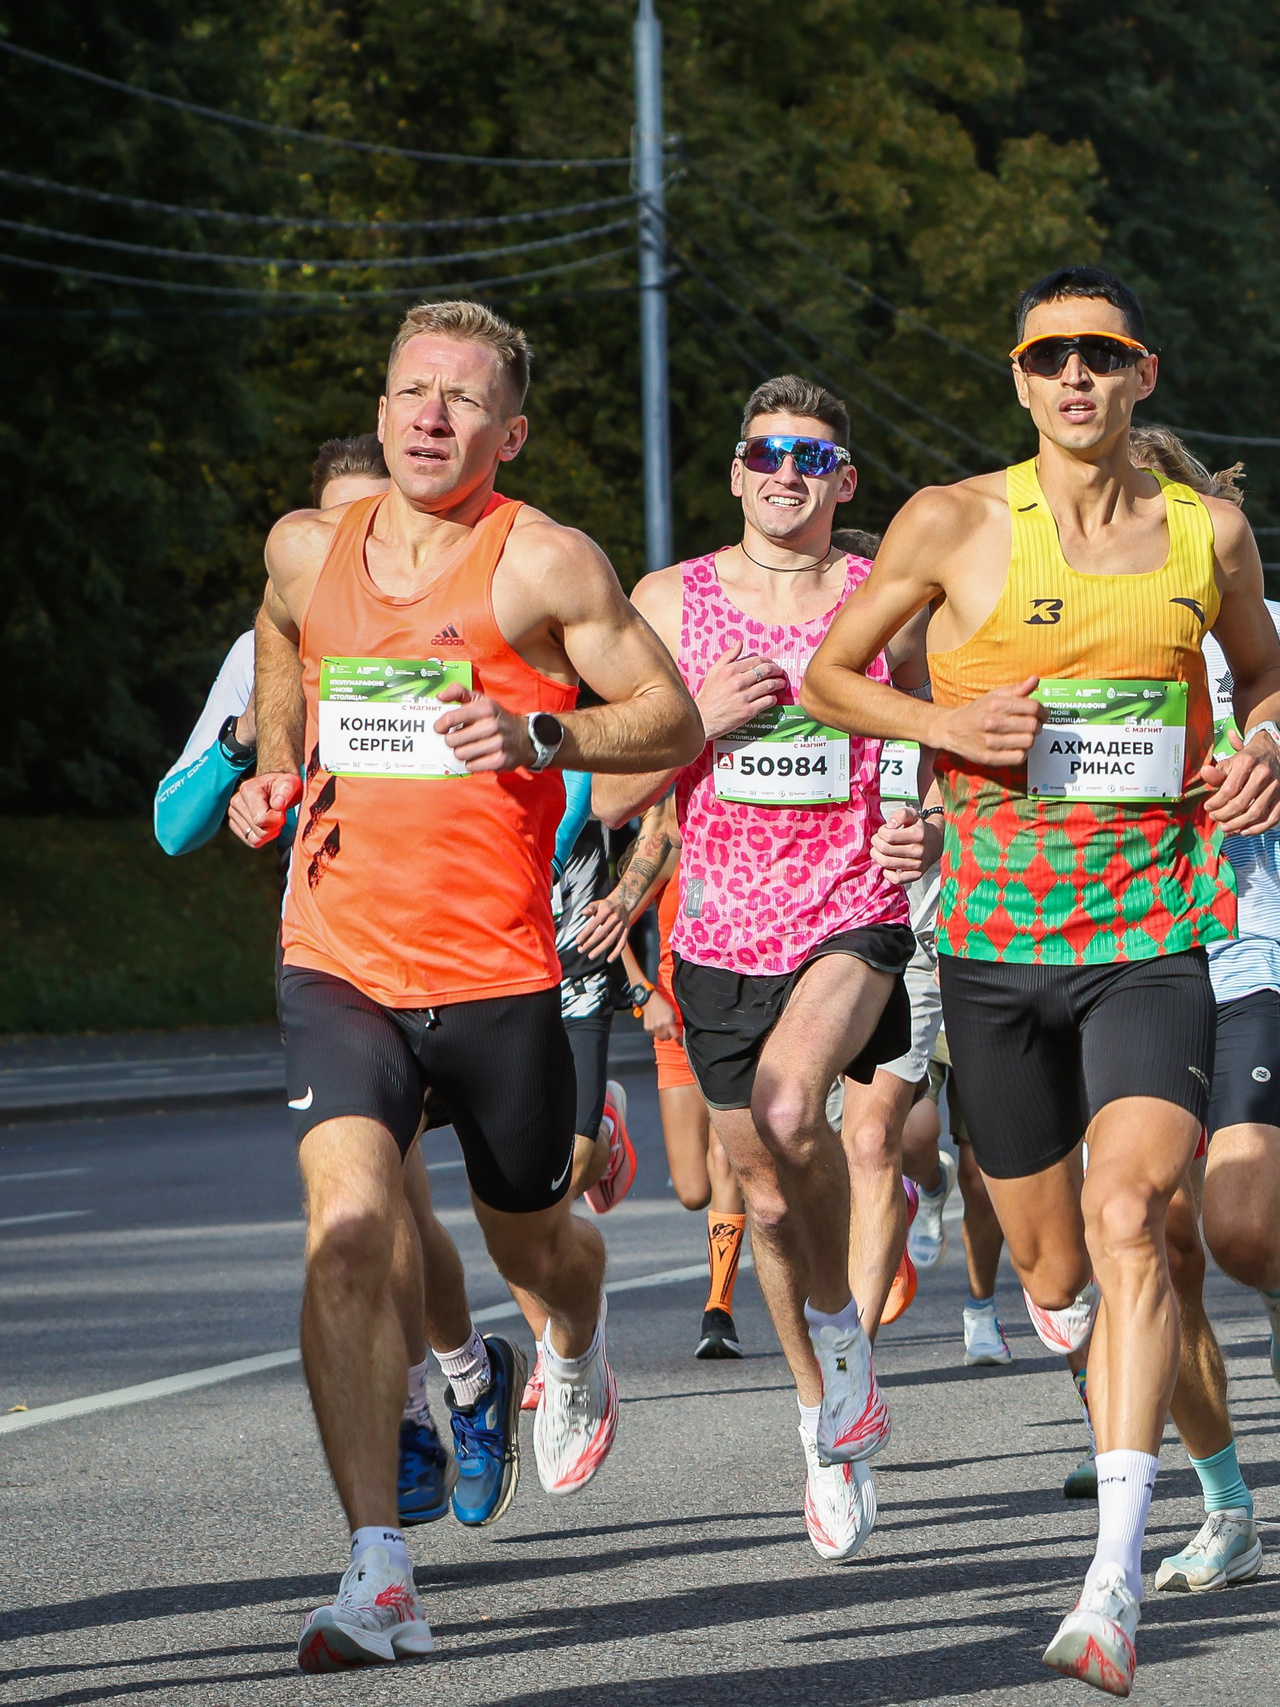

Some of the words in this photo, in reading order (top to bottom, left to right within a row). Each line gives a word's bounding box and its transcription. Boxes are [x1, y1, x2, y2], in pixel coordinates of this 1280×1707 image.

[431, 637, 465, 646] adidas
[340, 717, 425, 733] КОНЯКИН
[349, 735, 414, 752] СЕРГЕЙ
[1049, 740, 1154, 757] АХМАДЕЕВ
[740, 755, 828, 777] 50984
[1070, 761, 1136, 775] РИНАС
